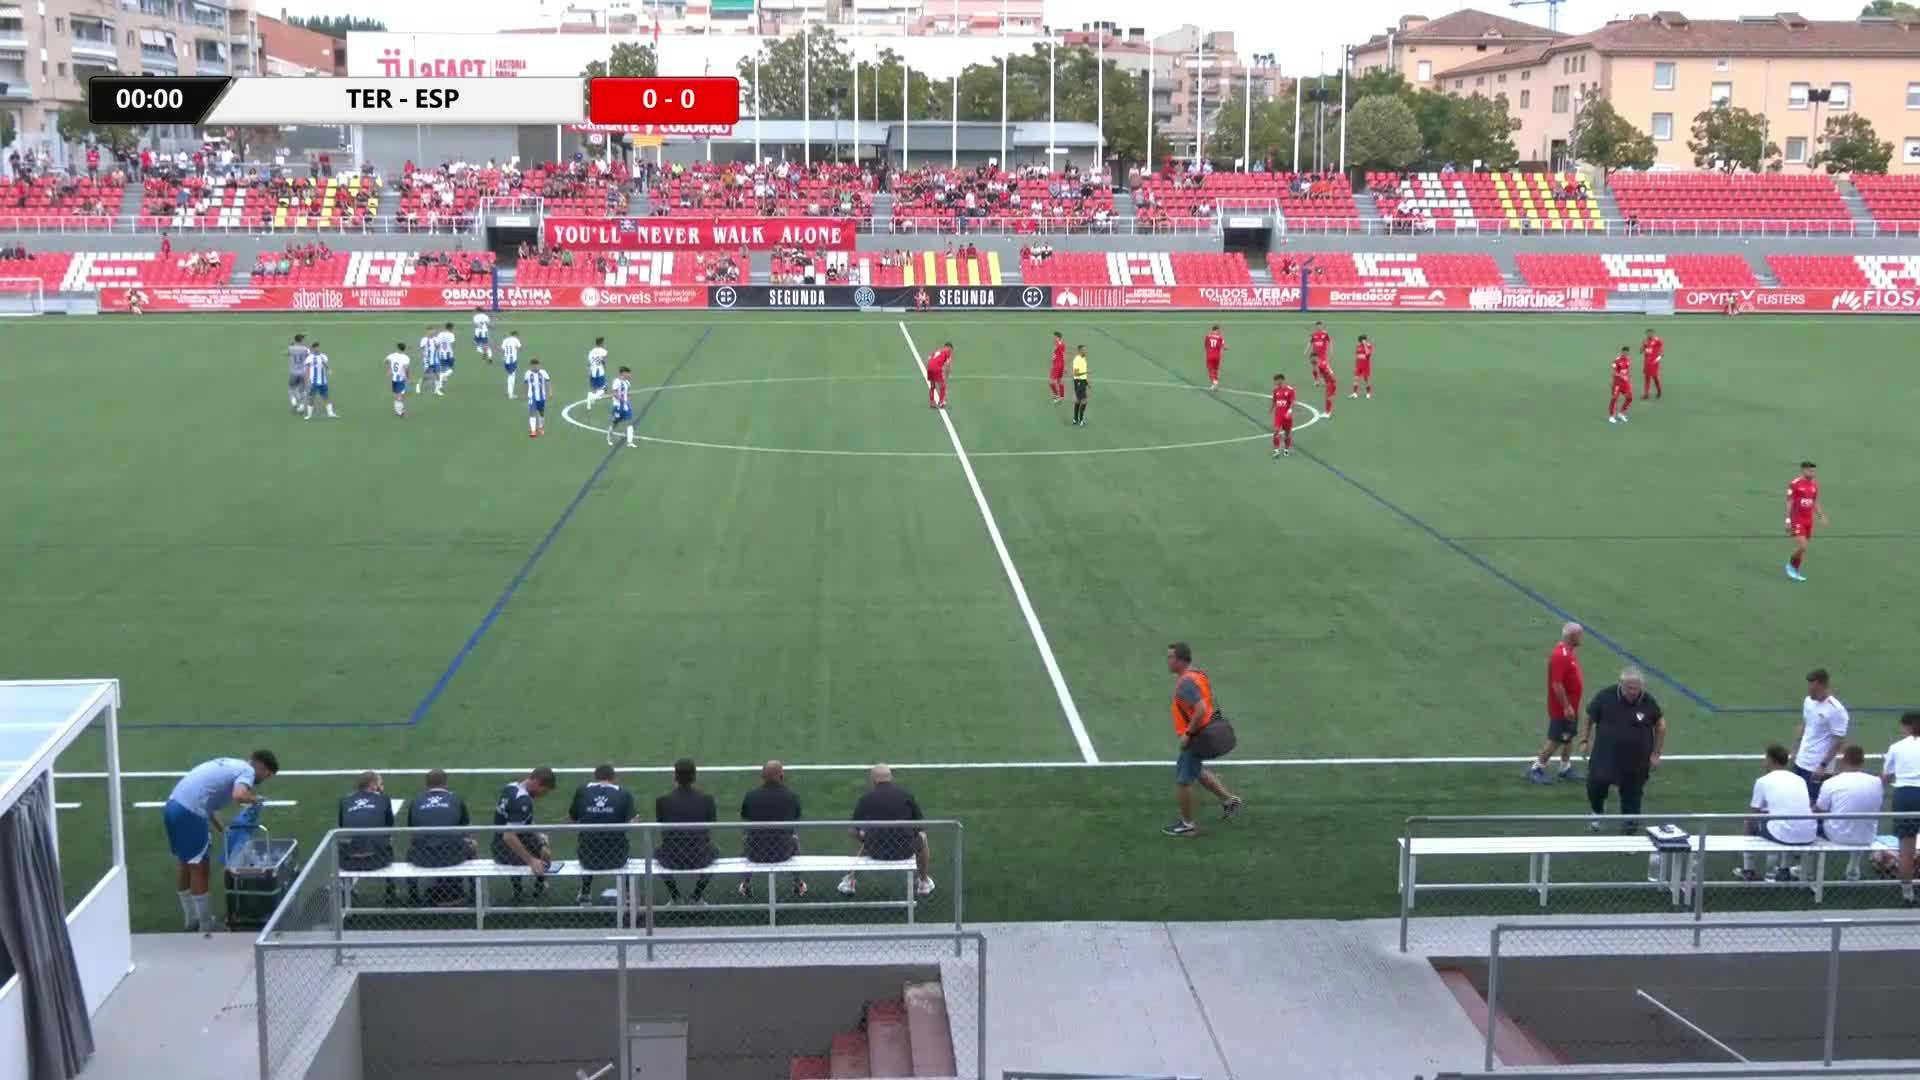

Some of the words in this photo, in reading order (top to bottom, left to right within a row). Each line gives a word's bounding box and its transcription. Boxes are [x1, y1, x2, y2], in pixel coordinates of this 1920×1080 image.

[553, 226, 622, 243] YOU'LL
[639, 227, 700, 244] NEVER
[711, 227, 765, 244] WALK
[781, 227, 842, 245] ALONE
[600, 290, 651, 303] Serveis
[769, 289, 825, 305] SEGUNDA
[939, 289, 995, 305] SEGUNDA
[1200, 288, 1248, 298] TOLDOS
[1254, 287, 1301, 299] YEBAR
[1757, 294, 1805, 304] FUSTERS
